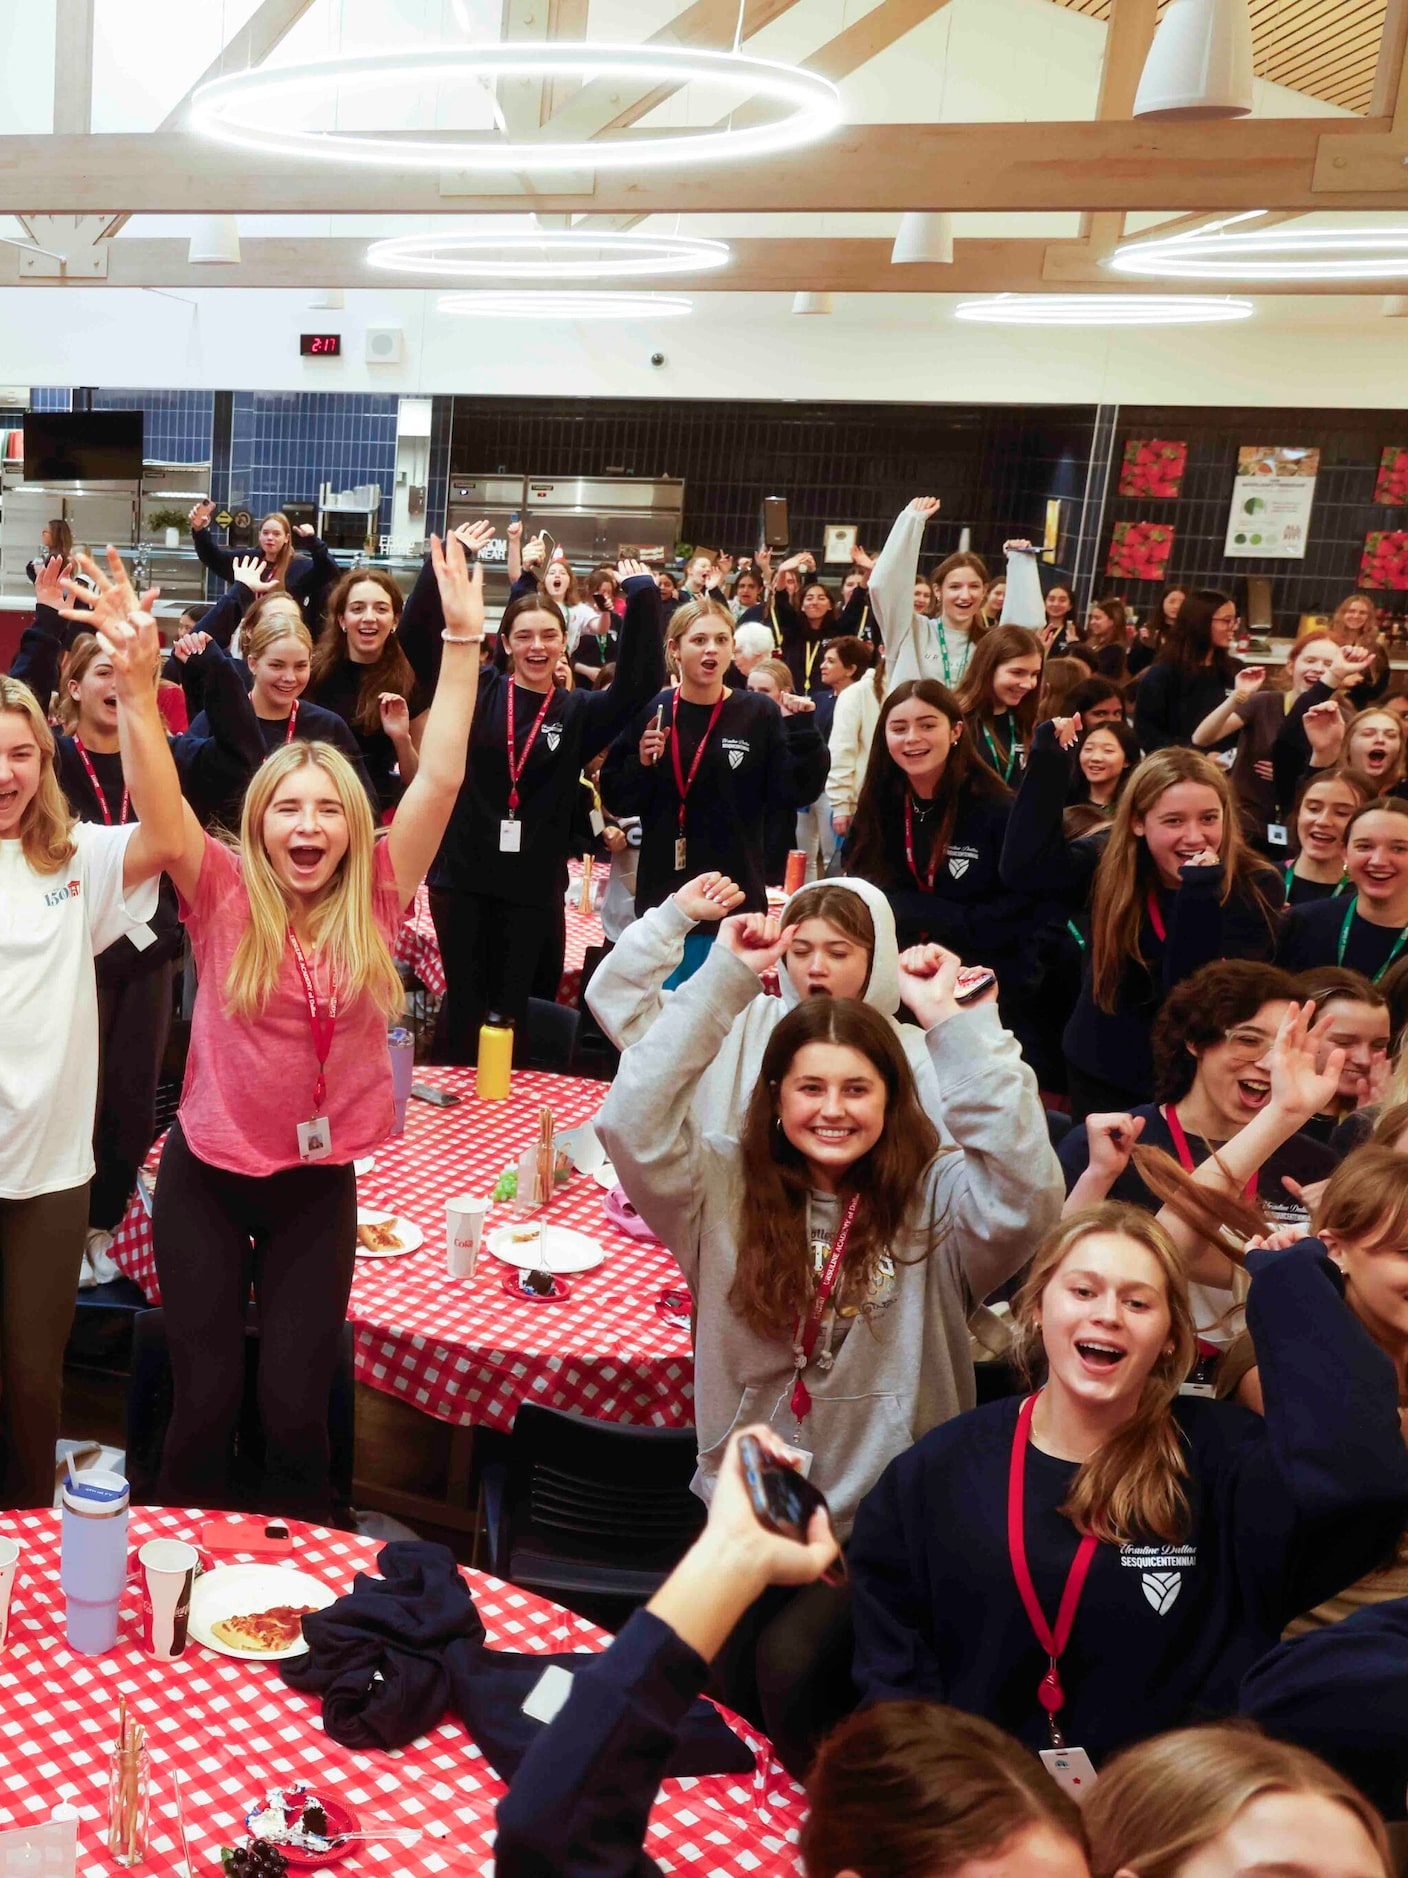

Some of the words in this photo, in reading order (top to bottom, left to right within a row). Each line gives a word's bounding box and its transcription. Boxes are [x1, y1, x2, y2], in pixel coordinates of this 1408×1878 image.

[311, 337, 336, 352] 2:17
[477, 548, 506, 560] NEAR
[45, 887, 69, 906] 150
[300, 963, 313, 992] ACADEMY
[823, 1252, 839, 1285] URSULINE
[848, 1211, 854, 1220] of
[1119, 1543, 1159, 1555] Ursuline
[1161, 1544, 1197, 1555] Dallas
